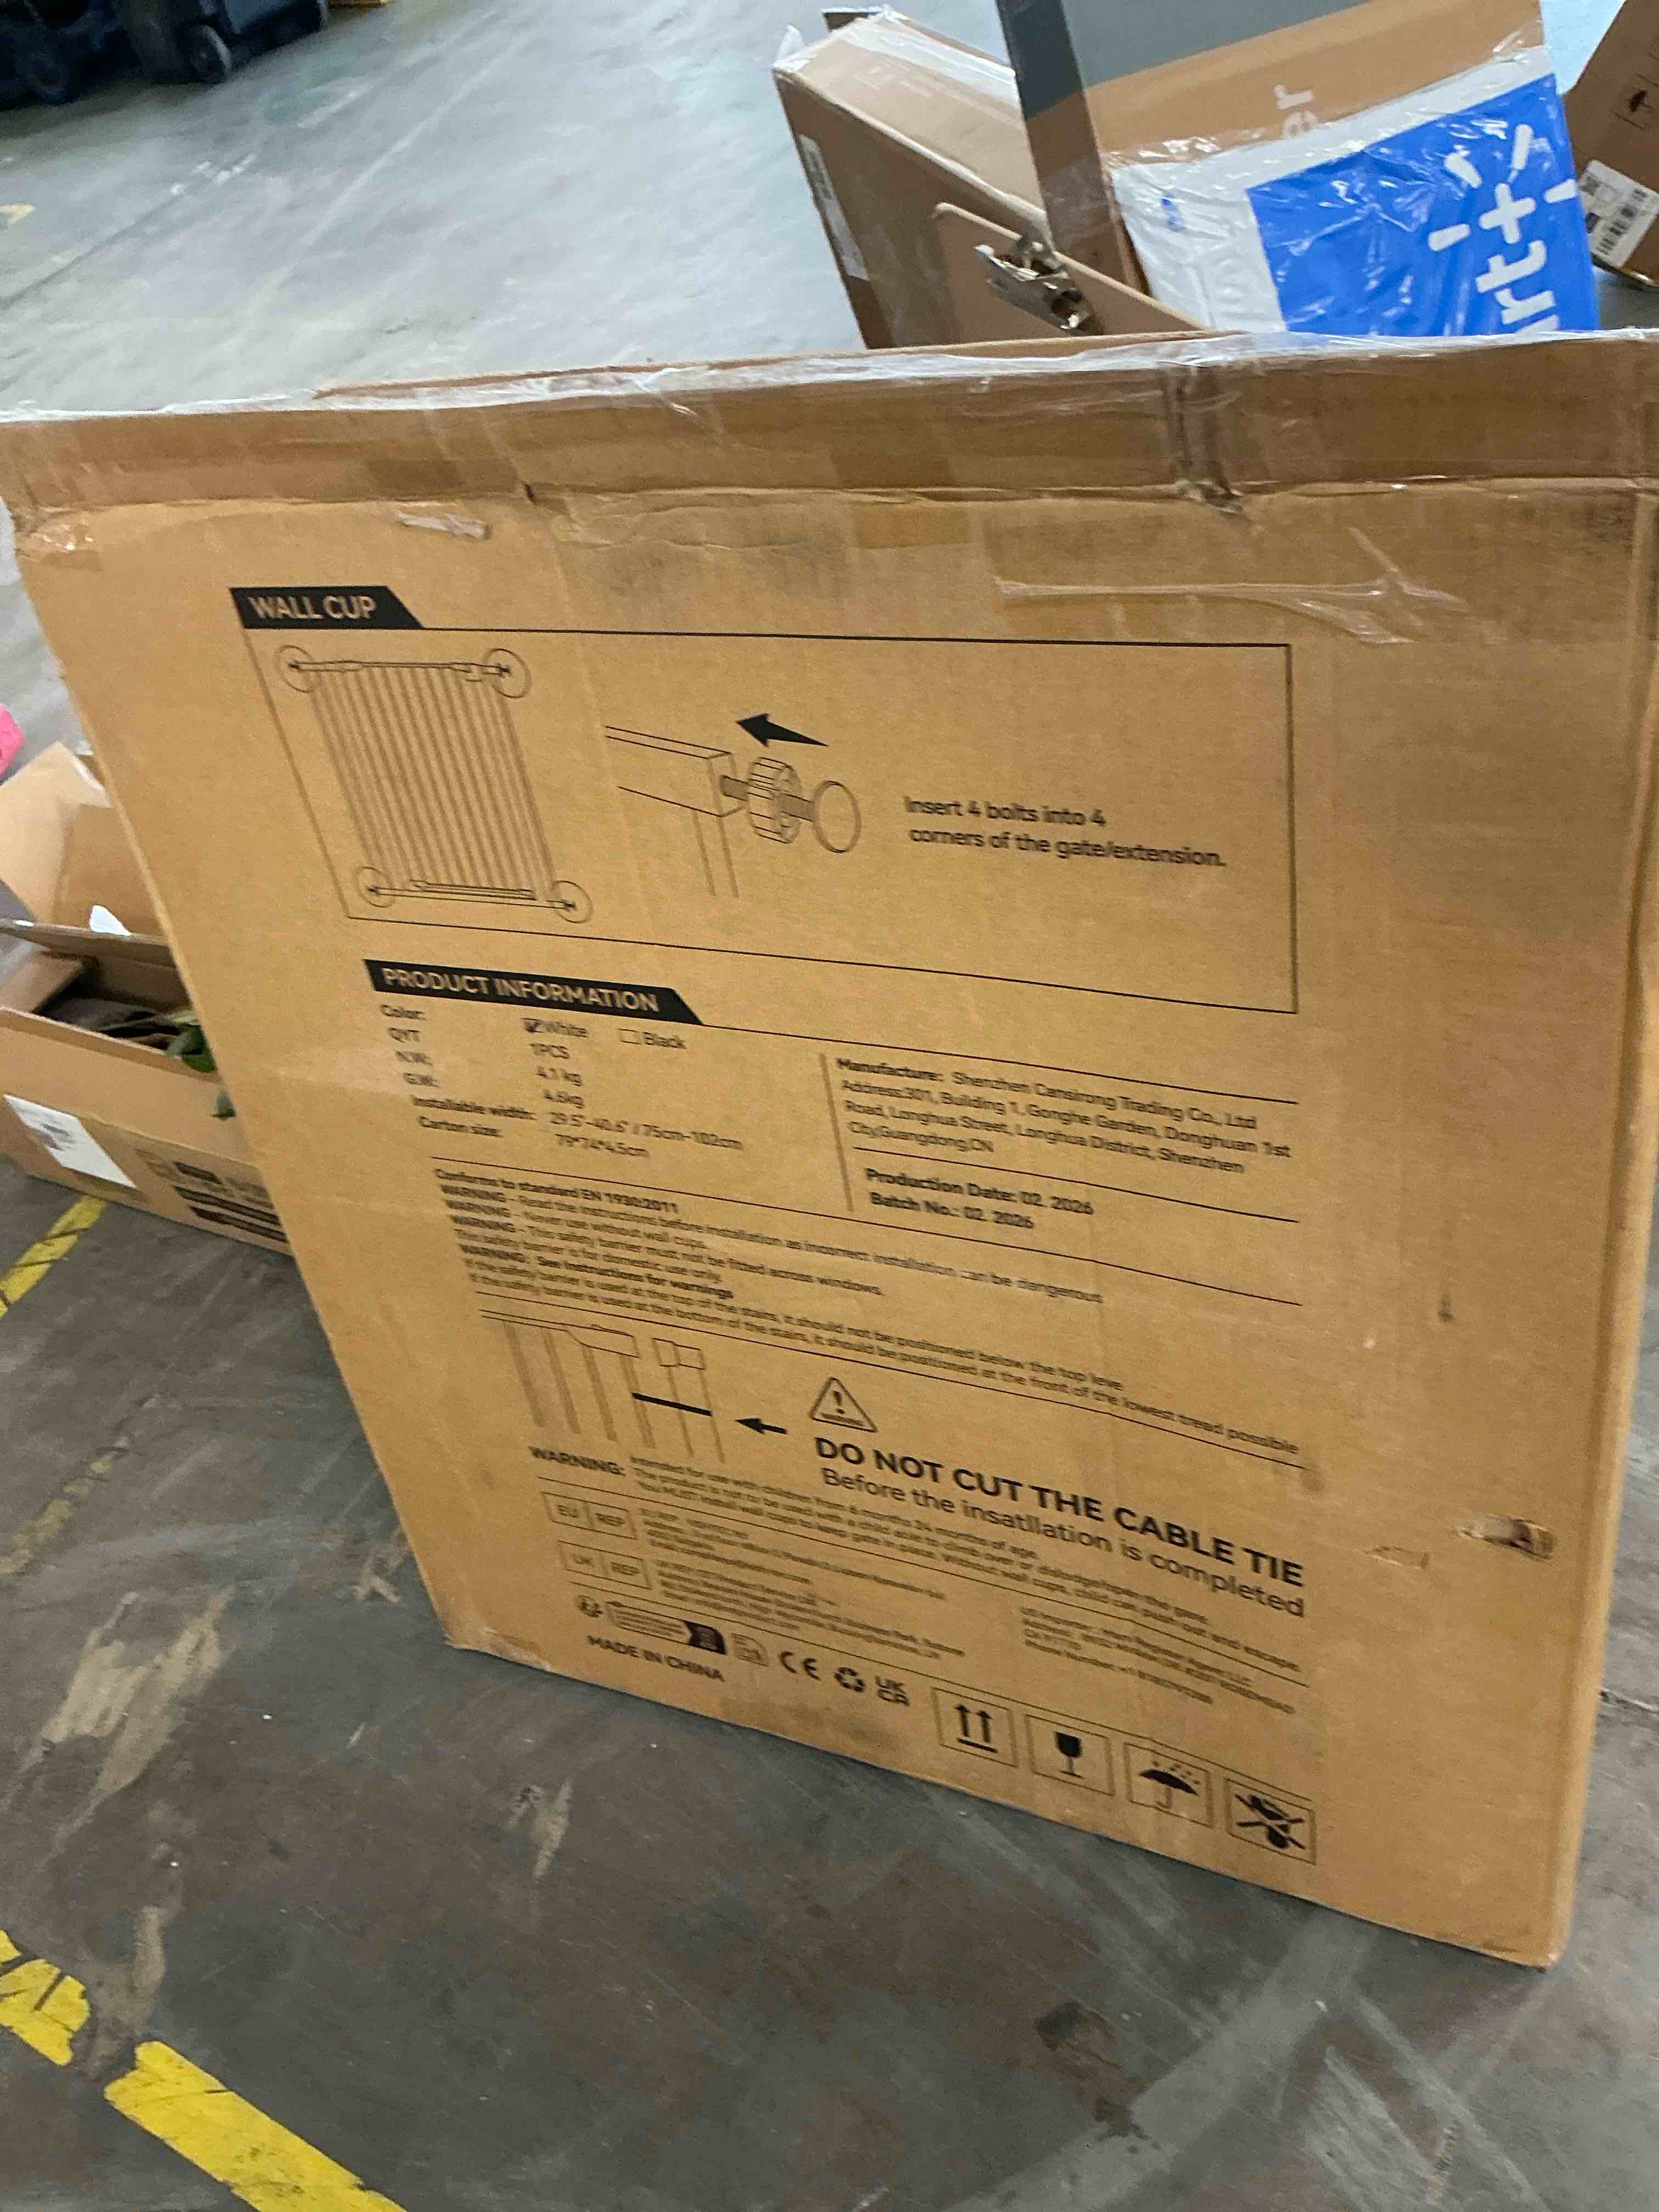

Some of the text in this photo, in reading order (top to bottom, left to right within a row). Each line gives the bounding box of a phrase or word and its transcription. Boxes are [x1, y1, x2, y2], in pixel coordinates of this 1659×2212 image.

[247, 596, 376, 620] WALL CUP
[904, 795, 1106, 827] Insert 4 bolts into 4
[910, 828, 984, 847] corners
[991, 832, 1011, 849] of
[1014, 834, 1049, 854] the
[382, 968, 659, 1012] PRODUCT INFORMATION
[642, 1031, 687, 1049] Black
[952, 1071, 1032, 1094] Shenzhen
[1121, 1097, 1184, 1122] Trading
[1227, 1112, 1257, 1130] Ltd
[941, 1091, 1005, 1115] Building
[1262, 1141, 1291, 1158] 1st
[1159, 1147, 1245, 1174] Shenzhen
[579, 1189, 603, 1200] EN
[865, 1167, 963, 1195] Production
[967, 1182, 1015, 1203] Date:
[1050, 1196, 1094, 1216] 2026
[870, 1192, 921, 1214] Batch
[992, 1211, 1035, 1231] 2026
[528, 1446, 627, 1476] WARNING:
[815, 1436, 1304, 1588] DO NOT CUT THE CABLE TIE
[821, 1468, 906, 1502] Before
[912, 1488, 956, 1514] the
[1121, 1538, 1142, 1563] is
[1147, 1550, 1305, 1618] completed
[588, 1635, 725, 1682] MADE IN CHINA
